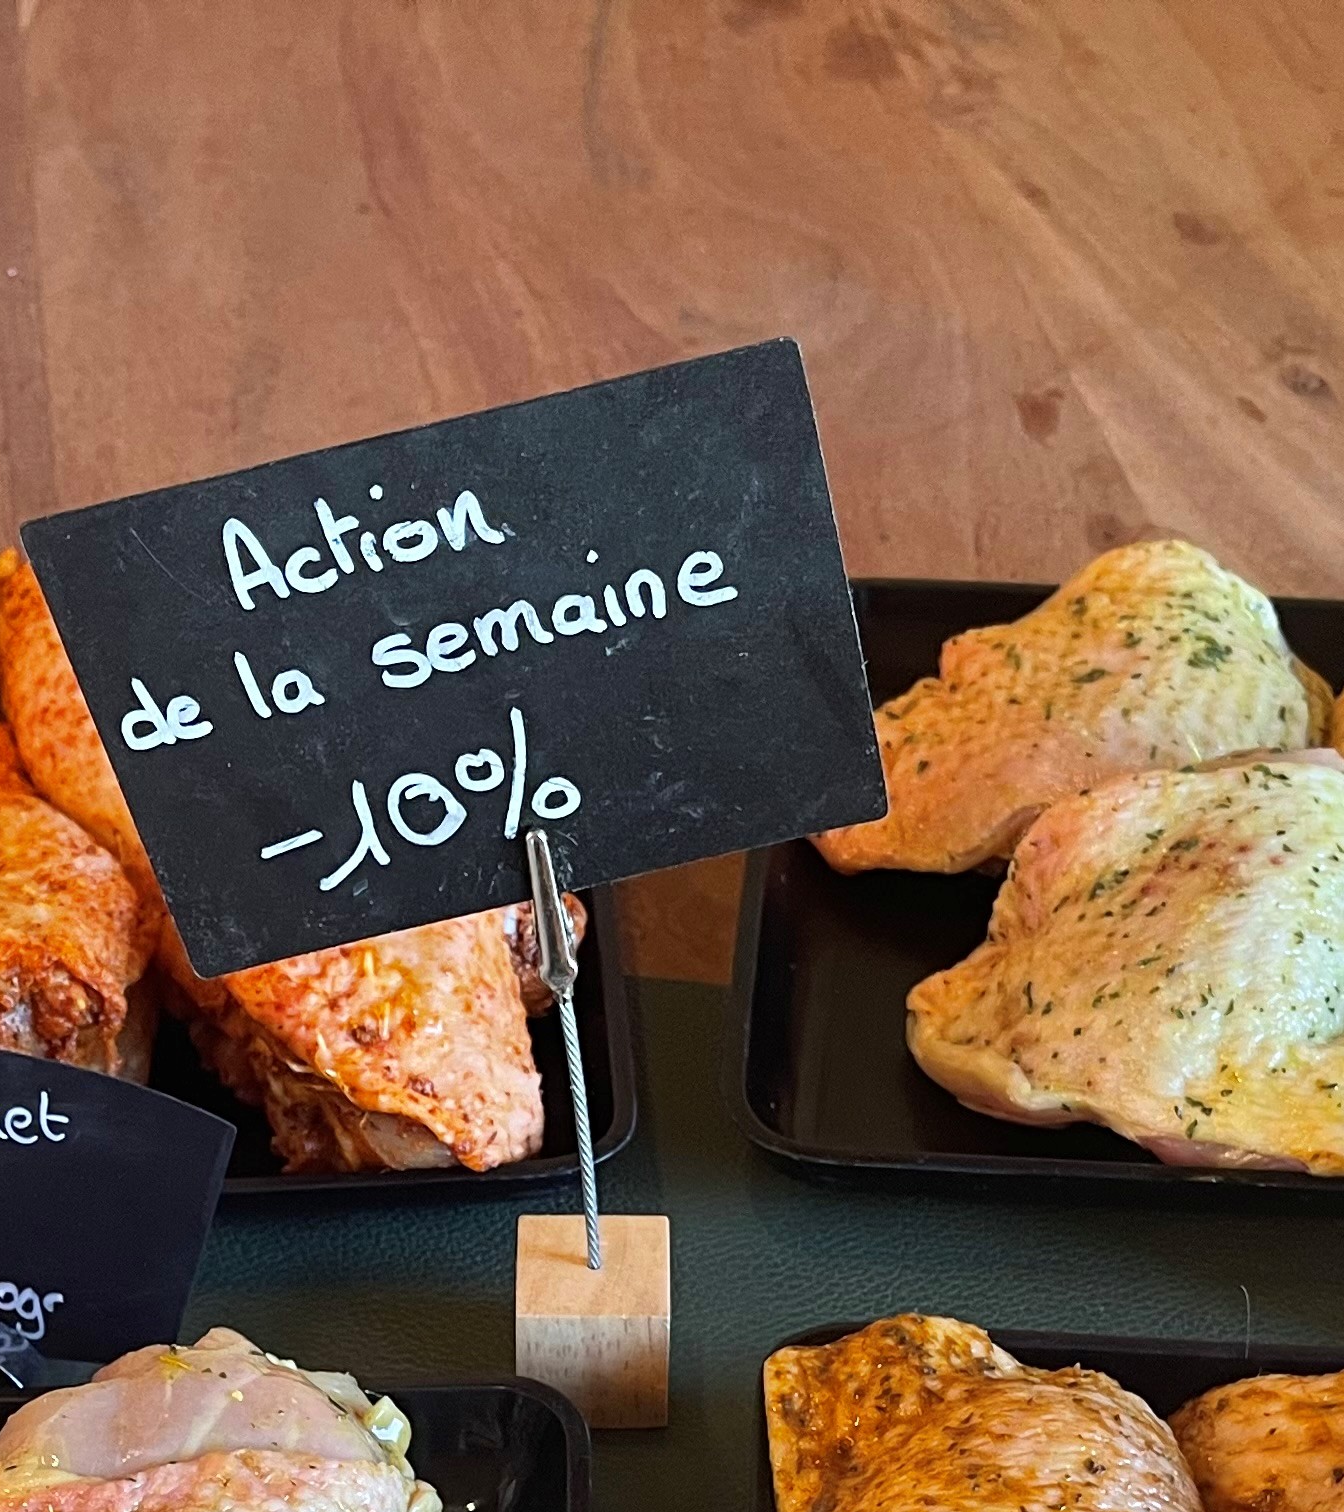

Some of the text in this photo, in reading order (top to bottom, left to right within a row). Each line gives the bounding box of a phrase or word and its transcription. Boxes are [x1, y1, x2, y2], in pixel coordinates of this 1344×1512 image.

[220, 485, 507, 610] Action
[121, 549, 738, 751] de la semaine
[261, 707, 581, 891] -10%
